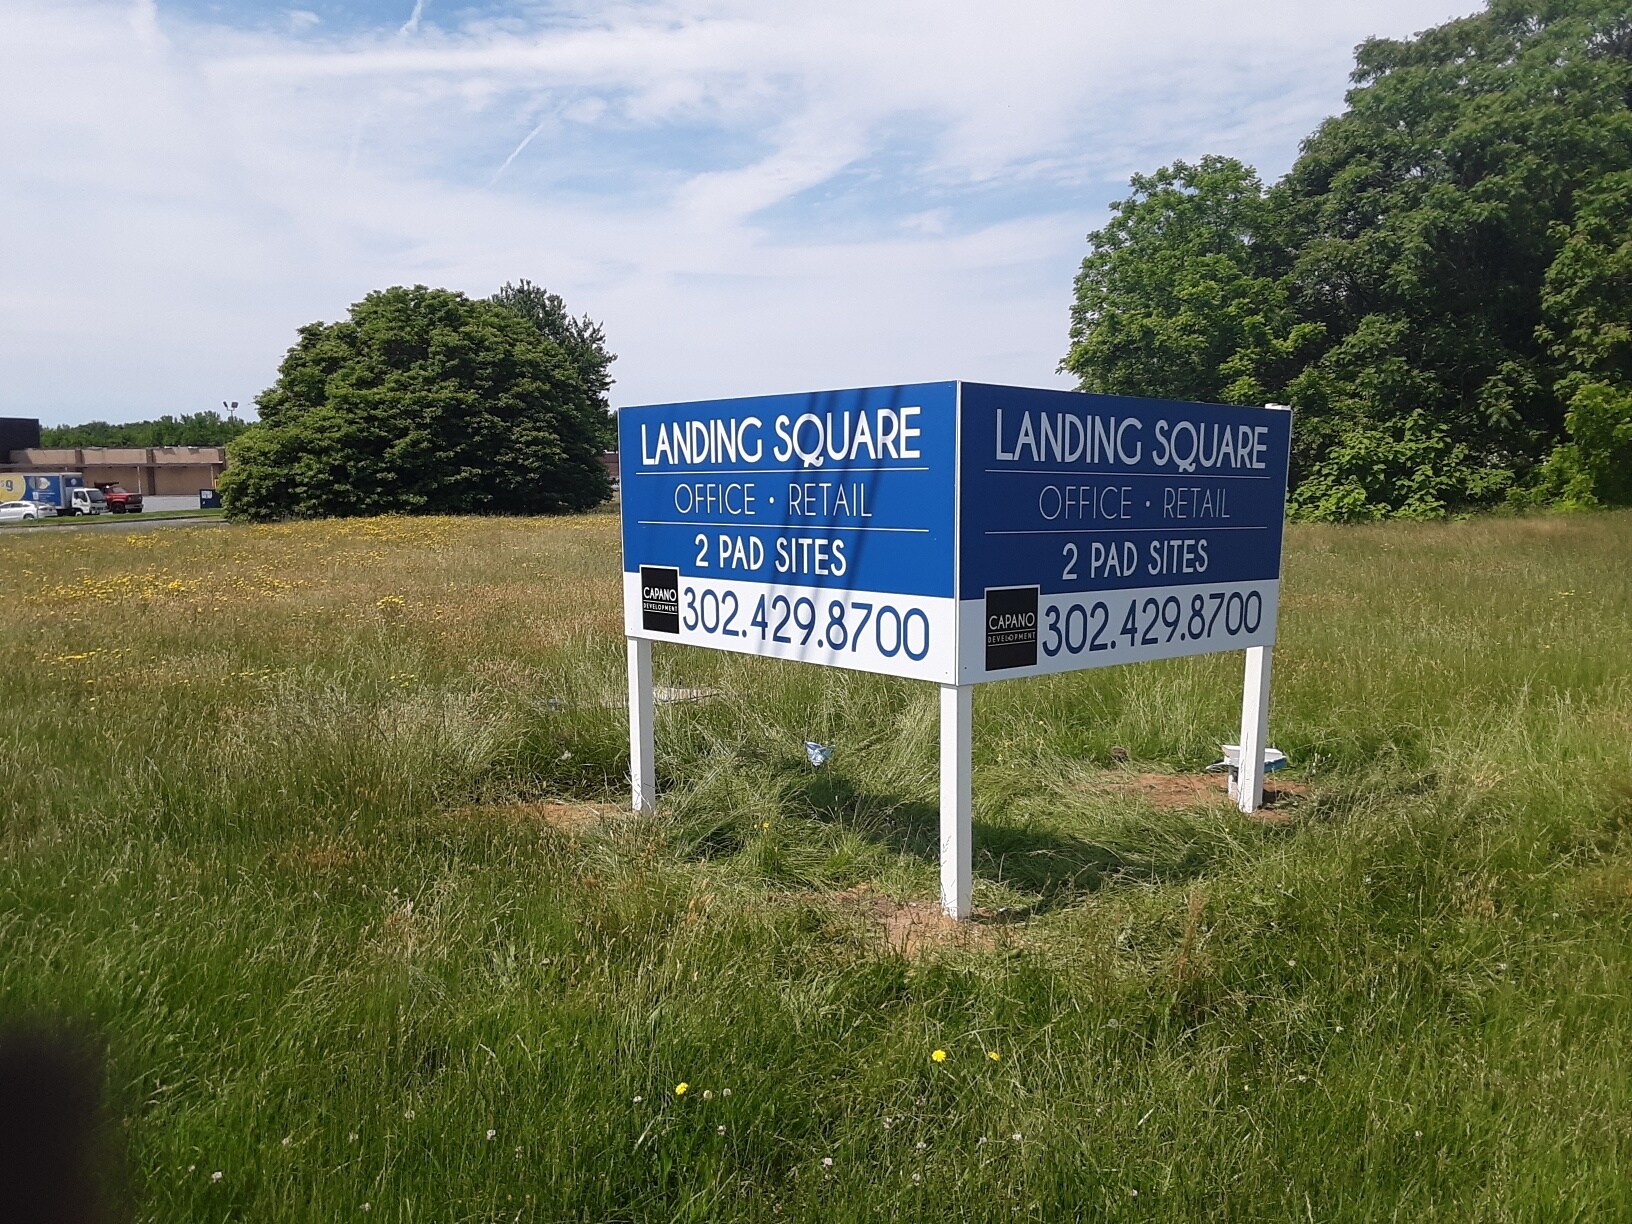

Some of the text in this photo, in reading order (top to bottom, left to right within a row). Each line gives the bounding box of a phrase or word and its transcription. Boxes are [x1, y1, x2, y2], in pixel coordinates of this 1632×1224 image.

[641, 406, 921, 468] LANDING SQUARE
[995, 408, 1269, 473] LANDING SQUARE
[674, 483, 873, 518] OFFICE RETAIL
[1039, 485, 1231, 520] OFFICE RETAIL
[694, 533, 847, 577] 2 PAD SITES
[1062, 539, 1209, 580] 2 PAD SITES
[643, 586, 677, 602] CAPANO
[643, 603, 678, 612] DEVELOPMENT
[683, 586, 930, 661] 302.429.8700
[987, 632, 1036, 644] DEVELOPMENT
[988, 612, 1035, 630] CAPANO
[1042, 590, 1263, 657] 302.429.8700
